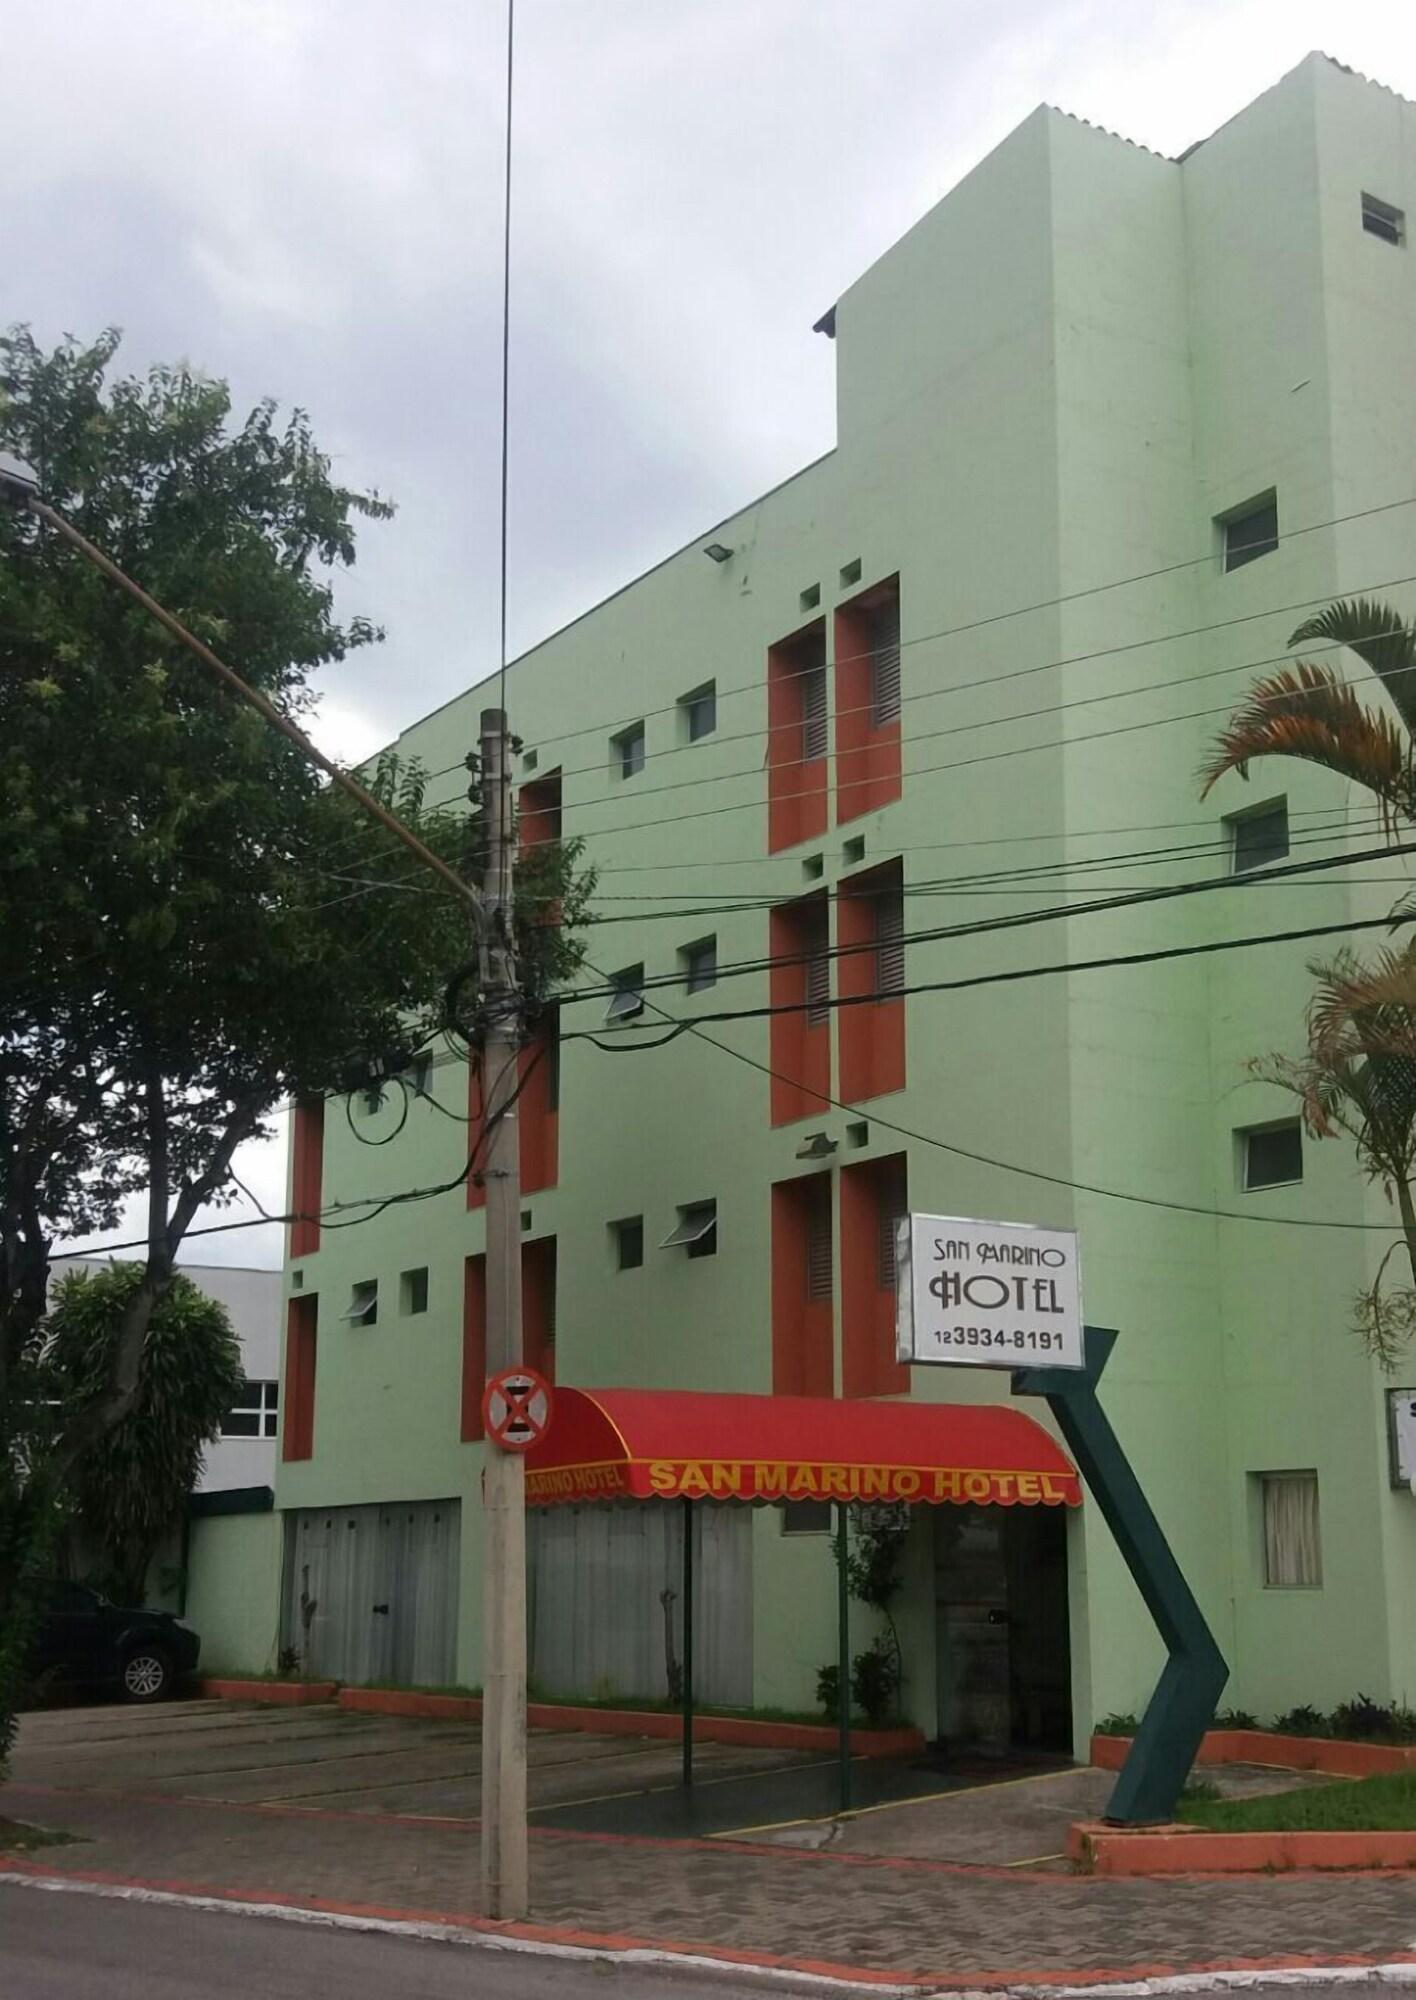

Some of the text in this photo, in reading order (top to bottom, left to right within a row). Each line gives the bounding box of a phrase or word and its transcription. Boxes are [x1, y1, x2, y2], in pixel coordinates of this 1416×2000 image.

[933, 1238, 1066, 1268] SAN MARINO
[928, 1270, 1065, 1314] HOTEL
[573, 1464, 624, 1489] HOTEL
[650, 1462, 1066, 1499] SAN MARINO HOTEL
